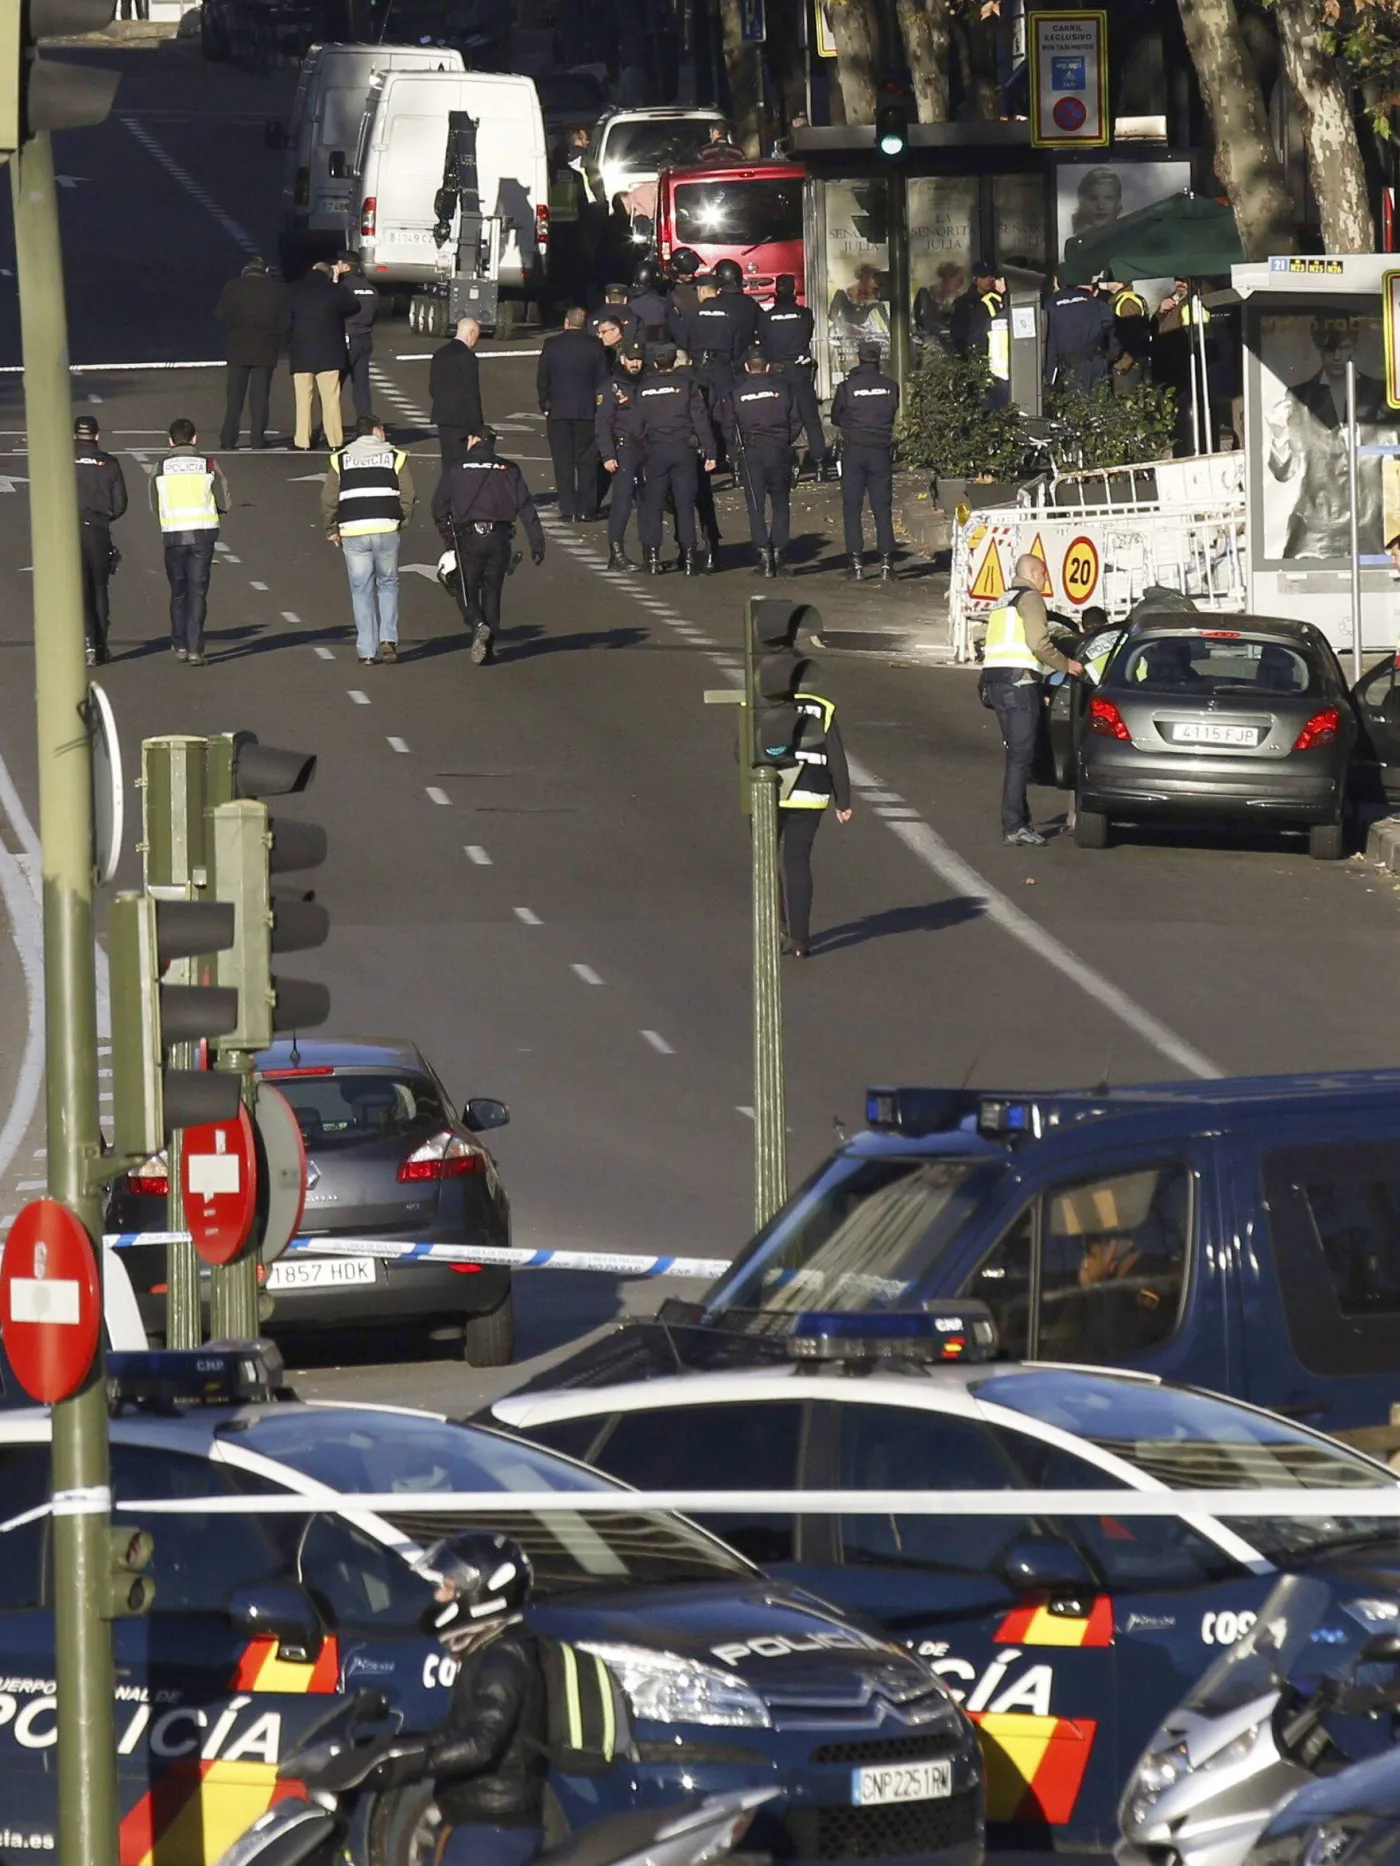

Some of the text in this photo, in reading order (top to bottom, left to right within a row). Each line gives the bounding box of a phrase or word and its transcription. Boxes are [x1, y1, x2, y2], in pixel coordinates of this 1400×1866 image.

[1052, 24, 1083, 32] CARRIL
[1273, 259, 1285, 270] 21
[165, 463, 205, 472] POLICIA
[1068, 557, 1092, 586] 20
[1182, 725, 1254, 742] 4115 FJP
[274, 1262, 369, 1283] 1857 HDK
[919, 1640, 950, 1657] DE
[0, 1676, 57, 1696] UERPO
